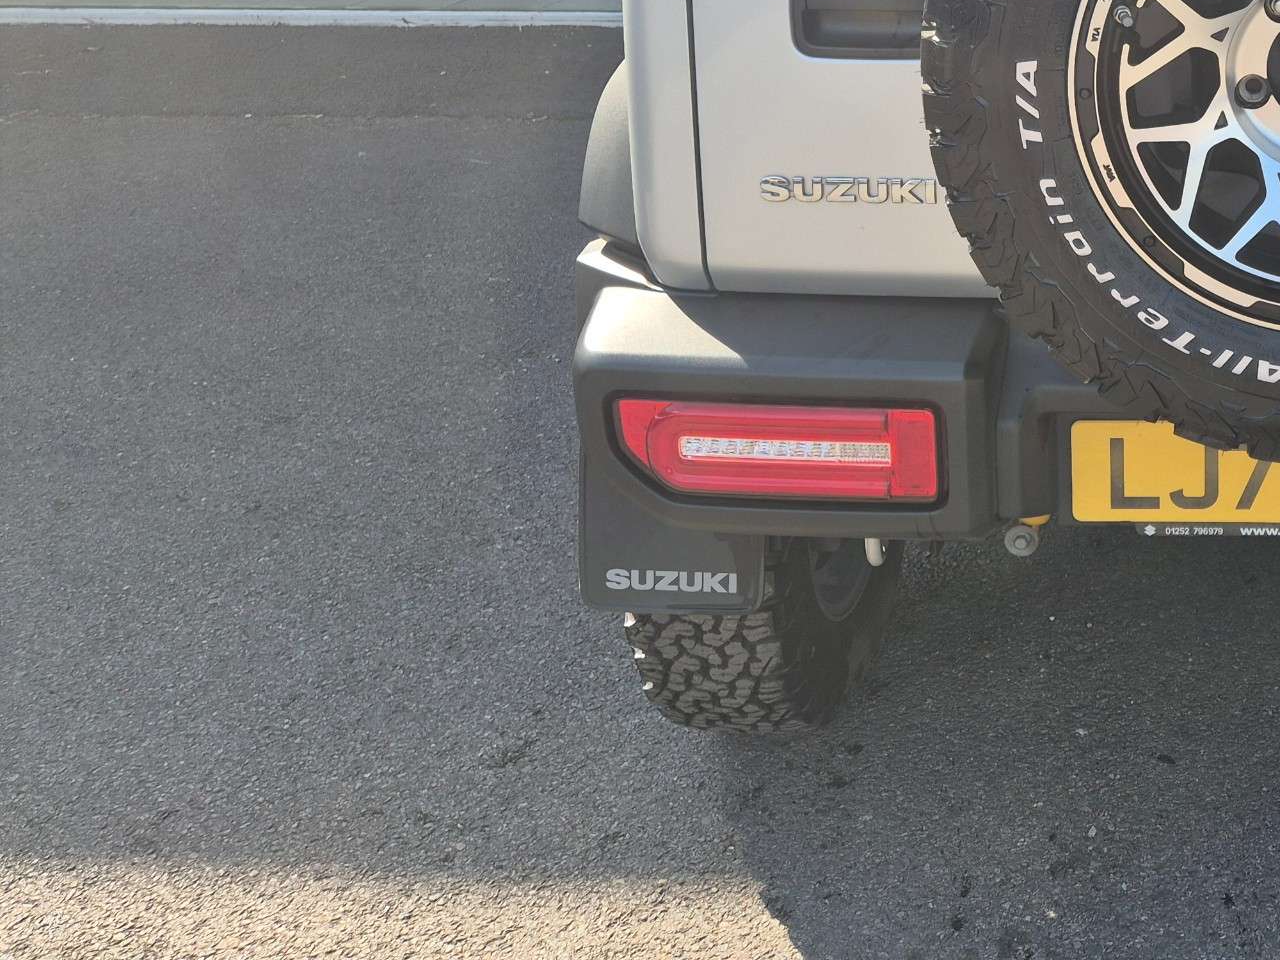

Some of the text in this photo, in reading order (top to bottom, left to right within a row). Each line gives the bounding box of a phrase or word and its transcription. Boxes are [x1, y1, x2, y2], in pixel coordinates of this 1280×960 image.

[1015, 60, 1043, 151] T/A
[760, 175, 938, 205] SUZUKI
[1165, 526, 1190, 536] 01252
[605, 568, 738, 594] SUZUKI
